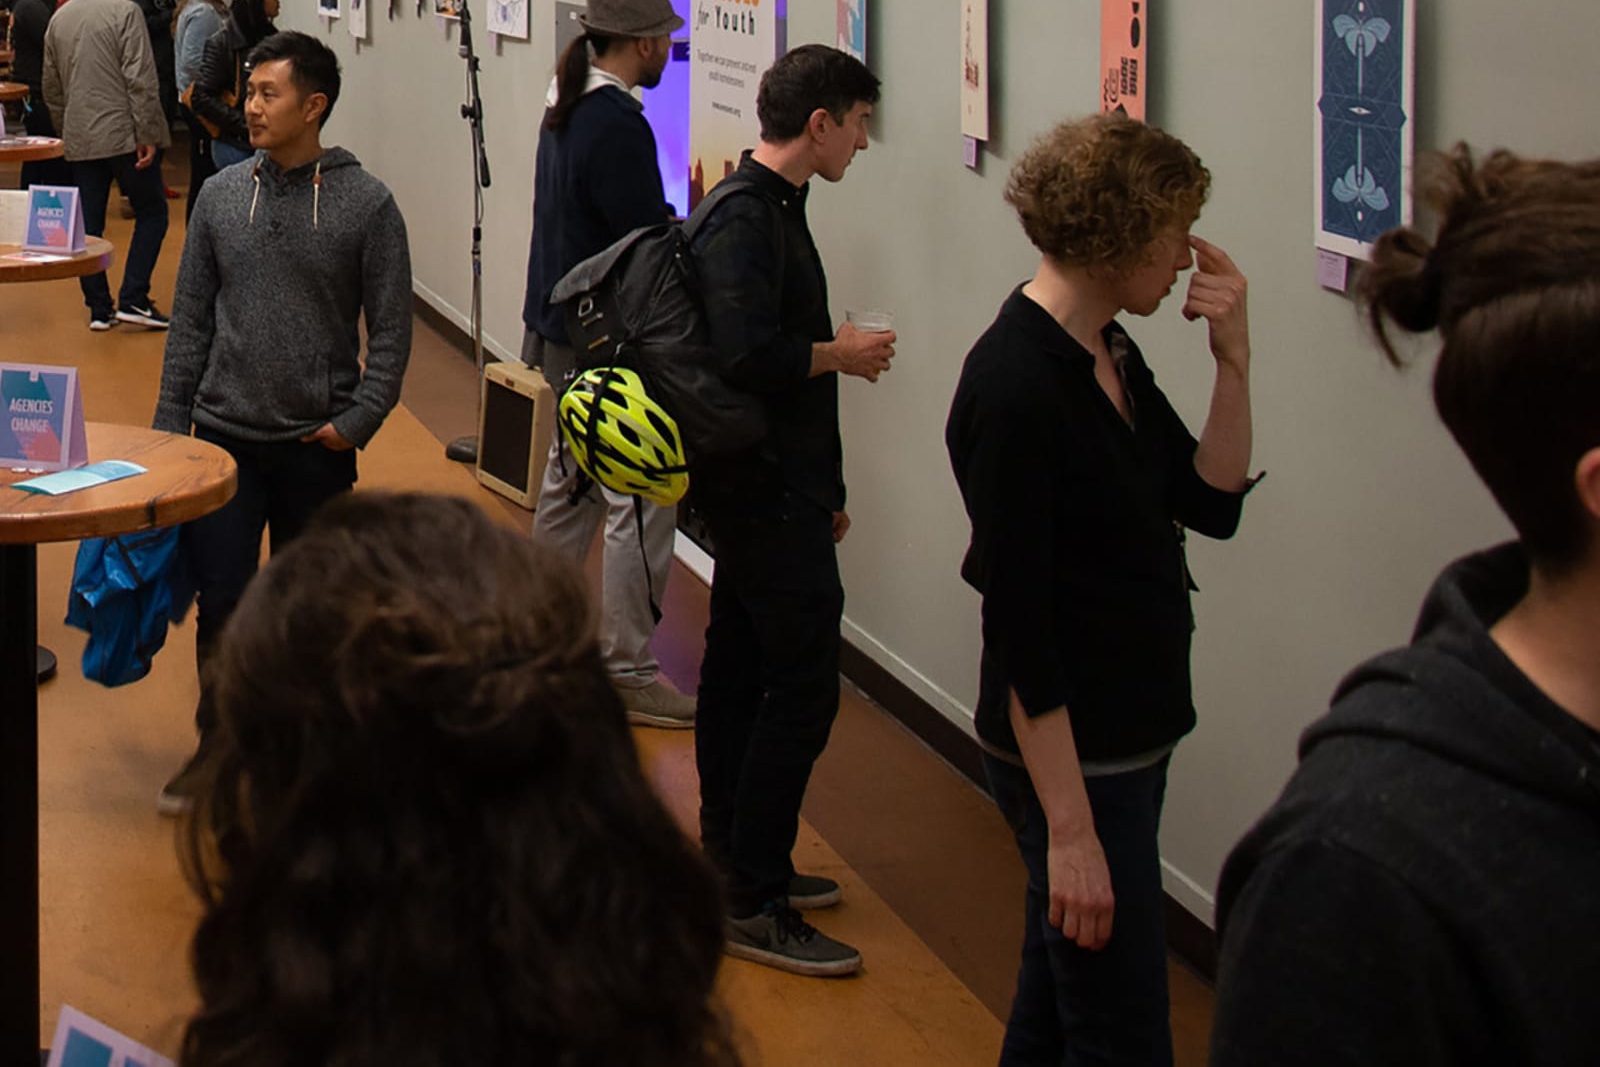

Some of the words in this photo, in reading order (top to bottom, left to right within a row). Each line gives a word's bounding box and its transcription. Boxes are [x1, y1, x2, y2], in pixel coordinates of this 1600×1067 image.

[695, 1, 709, 31] for
[715, 5, 755, 36] Youth
[9, 397, 53, 415] AGENCIES
[11, 416, 50, 433] CHANGE
